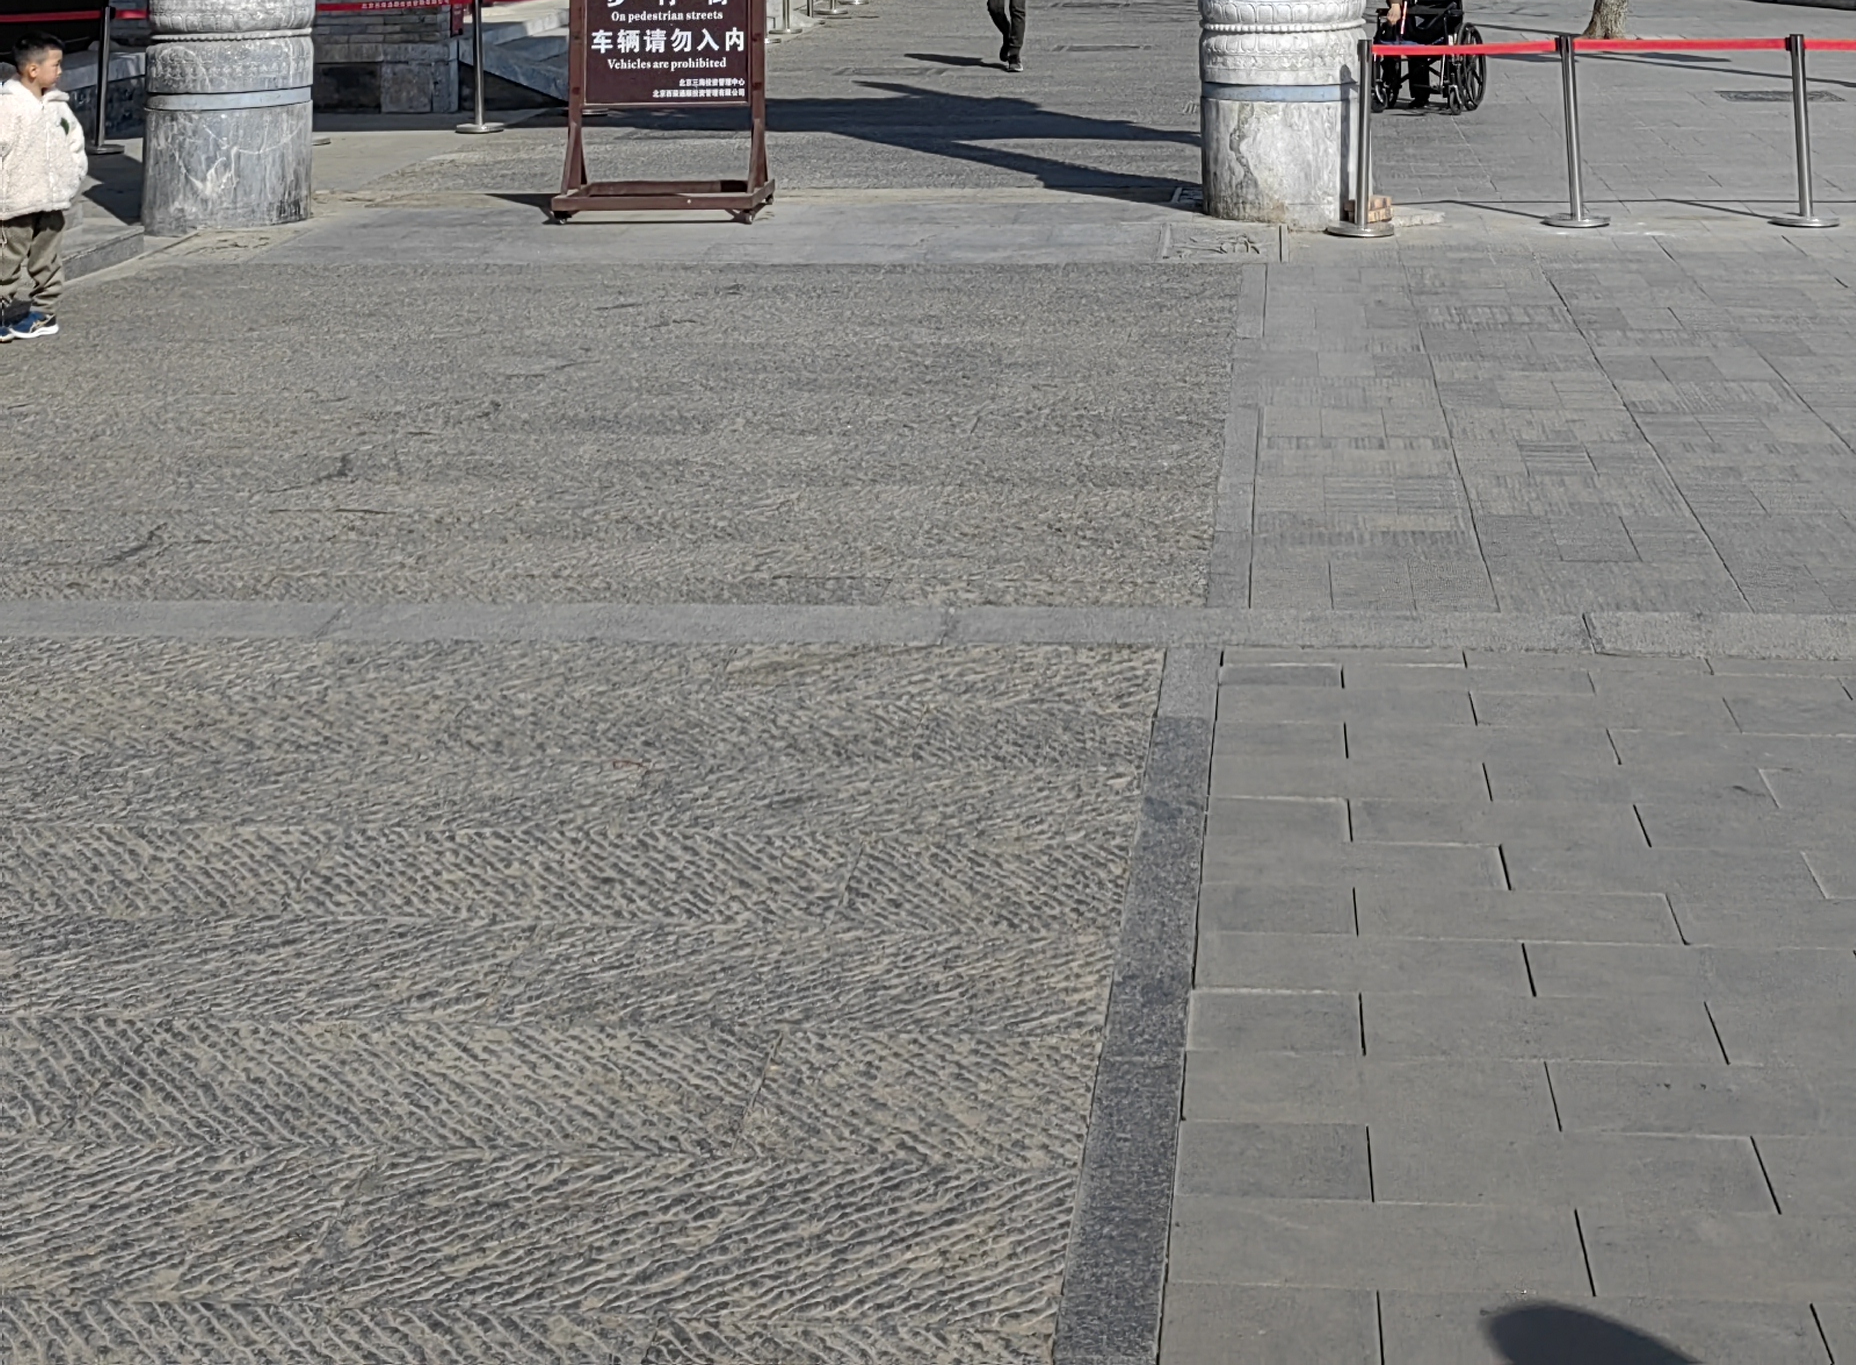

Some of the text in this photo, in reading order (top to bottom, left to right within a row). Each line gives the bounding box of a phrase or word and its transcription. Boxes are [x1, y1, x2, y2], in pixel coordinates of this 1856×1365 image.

[611, 10, 724, 24] On pedestrian streets
[590, 27, 745, 54] 车辆请勿入内
[607, 56, 727, 72] Vehicles are prohibited
